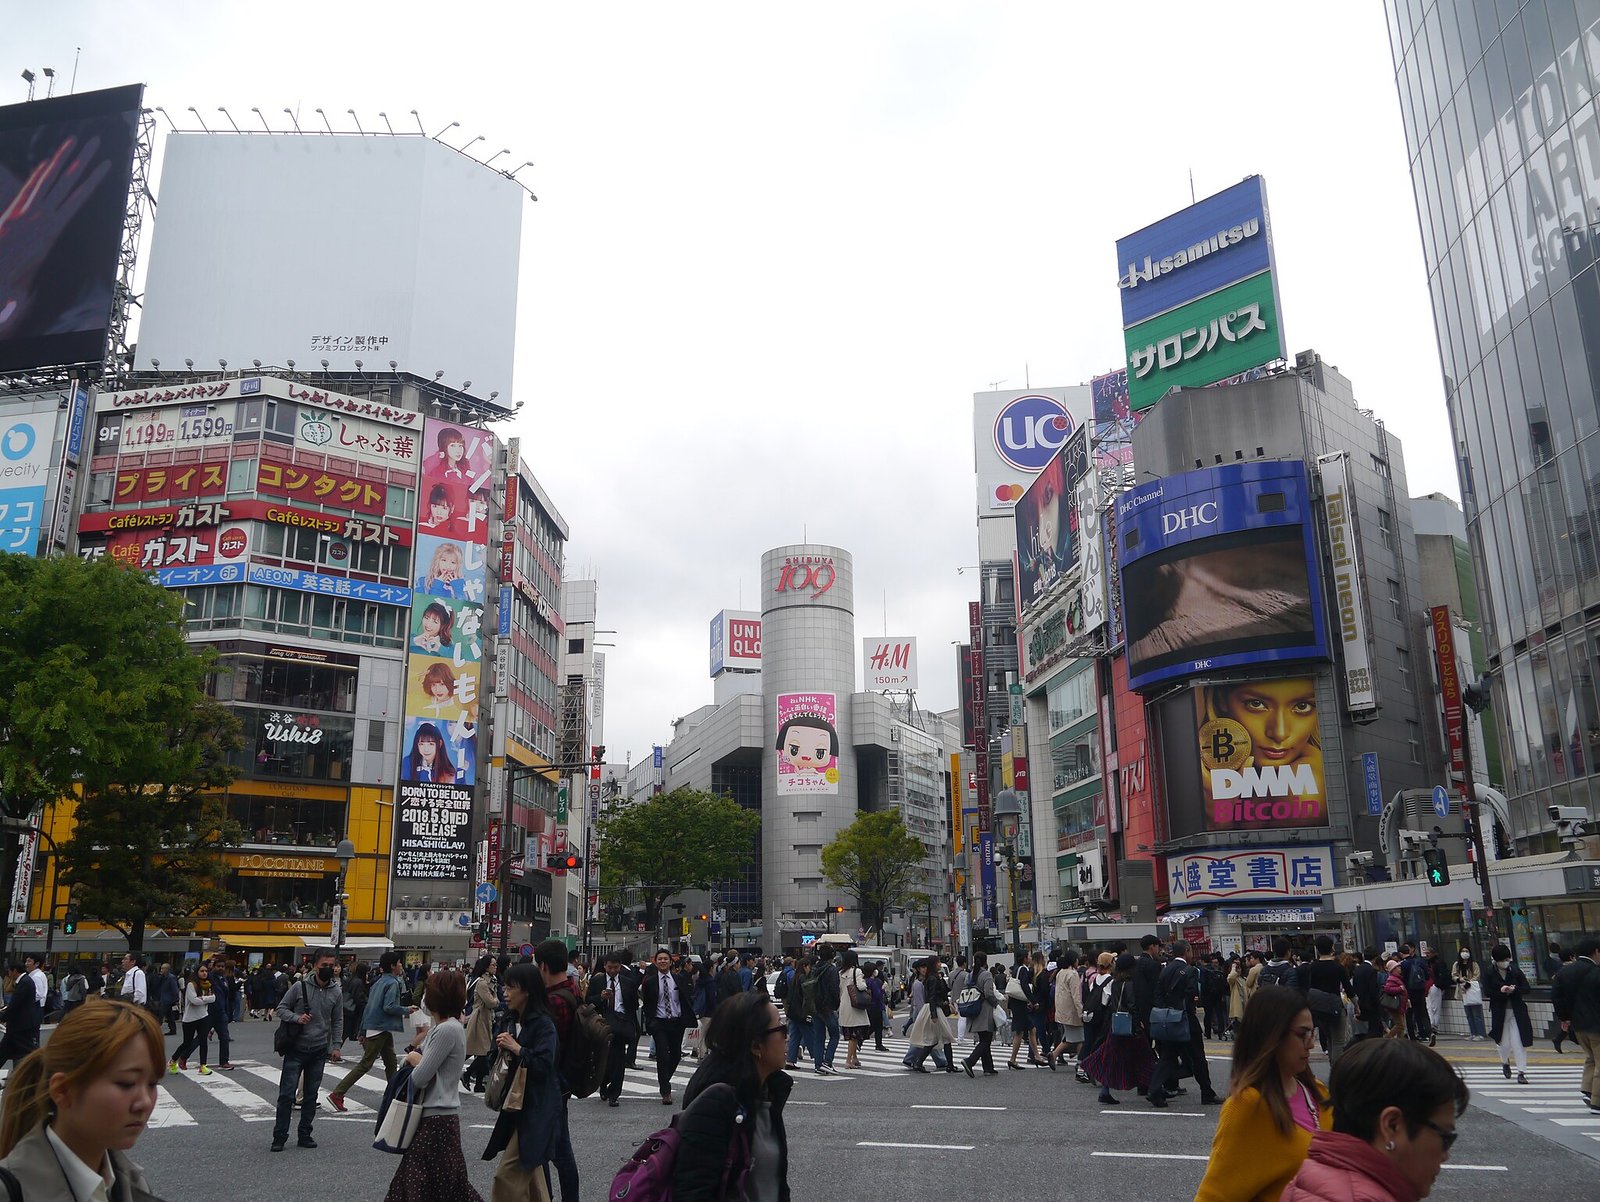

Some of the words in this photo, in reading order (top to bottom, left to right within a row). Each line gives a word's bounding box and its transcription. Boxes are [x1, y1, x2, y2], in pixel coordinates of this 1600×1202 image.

[1117, 217, 1260, 288] Hisamitsu
[311, 335, 389, 346] デザイン製作中
[1130, 302, 1266, 379] サロンパス
[112, 381, 231, 408] しゃぶしゃぶバイキング
[288, 383, 418, 425] しゃぶしゃぶバイキング
[99, 425, 119, 442] 9F
[125, 422, 175, 448] 1,199円
[180, 416, 233, 443] 1,599円
[339, 422, 414, 459] しゃぶ葉
[117, 464, 224, 497] プライス
[258, 463, 382, 506] コンタクト
[1119, 501, 1134, 515] DHC
[1134, 486, 1164, 509] Channel
[108, 512, 174, 529] Caféレストラン
[176, 503, 230, 528] ガスト
[267, 508, 340, 533] Caféレストラン
[343, 519, 400, 546] ガスト
[1162, 501, 1219, 536] DHC
[81, 546, 106, 565] 7F
[111, 544, 141, 558] Café
[141, 536, 210, 568] ガスト
[221, 540, 245, 550] ガスト
[503, 552, 512, 577] ガスト
[785, 556, 834, 565] SHIBUYA
[221, 566, 236, 579] 6F
[254, 567, 293, 584] AEON
[774, 563, 836, 601] 109
[1336, 572, 1358, 643] neon
[733, 623, 761, 638] UNI
[870, 643, 911, 671] H&M
[1194, 660, 1212, 670] DHC
[874, 676, 899, 684] 150m
[269, 711, 294, 724] 渋谷
[264, 722, 323, 745] Ushi8
[788, 778, 826, 787] チコちゃん
[1210, 763, 1319, 800] DMM
[401, 786, 426, 798] BORN
[427, 788, 439, 799] TO
[439, 789, 450, 799] BE
[451, 790, 471, 801] IDOL
[402, 808, 449, 825] 2018.5.9
[449, 811, 469, 826] WED
[1214, 797, 1320, 823] Bitcoin
[412, 823, 457, 837] RELEASE
[402, 839, 466, 850] HISASHI(GLAY)
[239, 854, 325, 872] L'OCCITANE
[412, 863, 468, 872] 中野サンプラザホール
[412, 870, 456, 878] NHK大阪ホール
[268, 871, 310, 879] PROVENCE
[1172, 855, 1323, 896] 大盛堂書店
